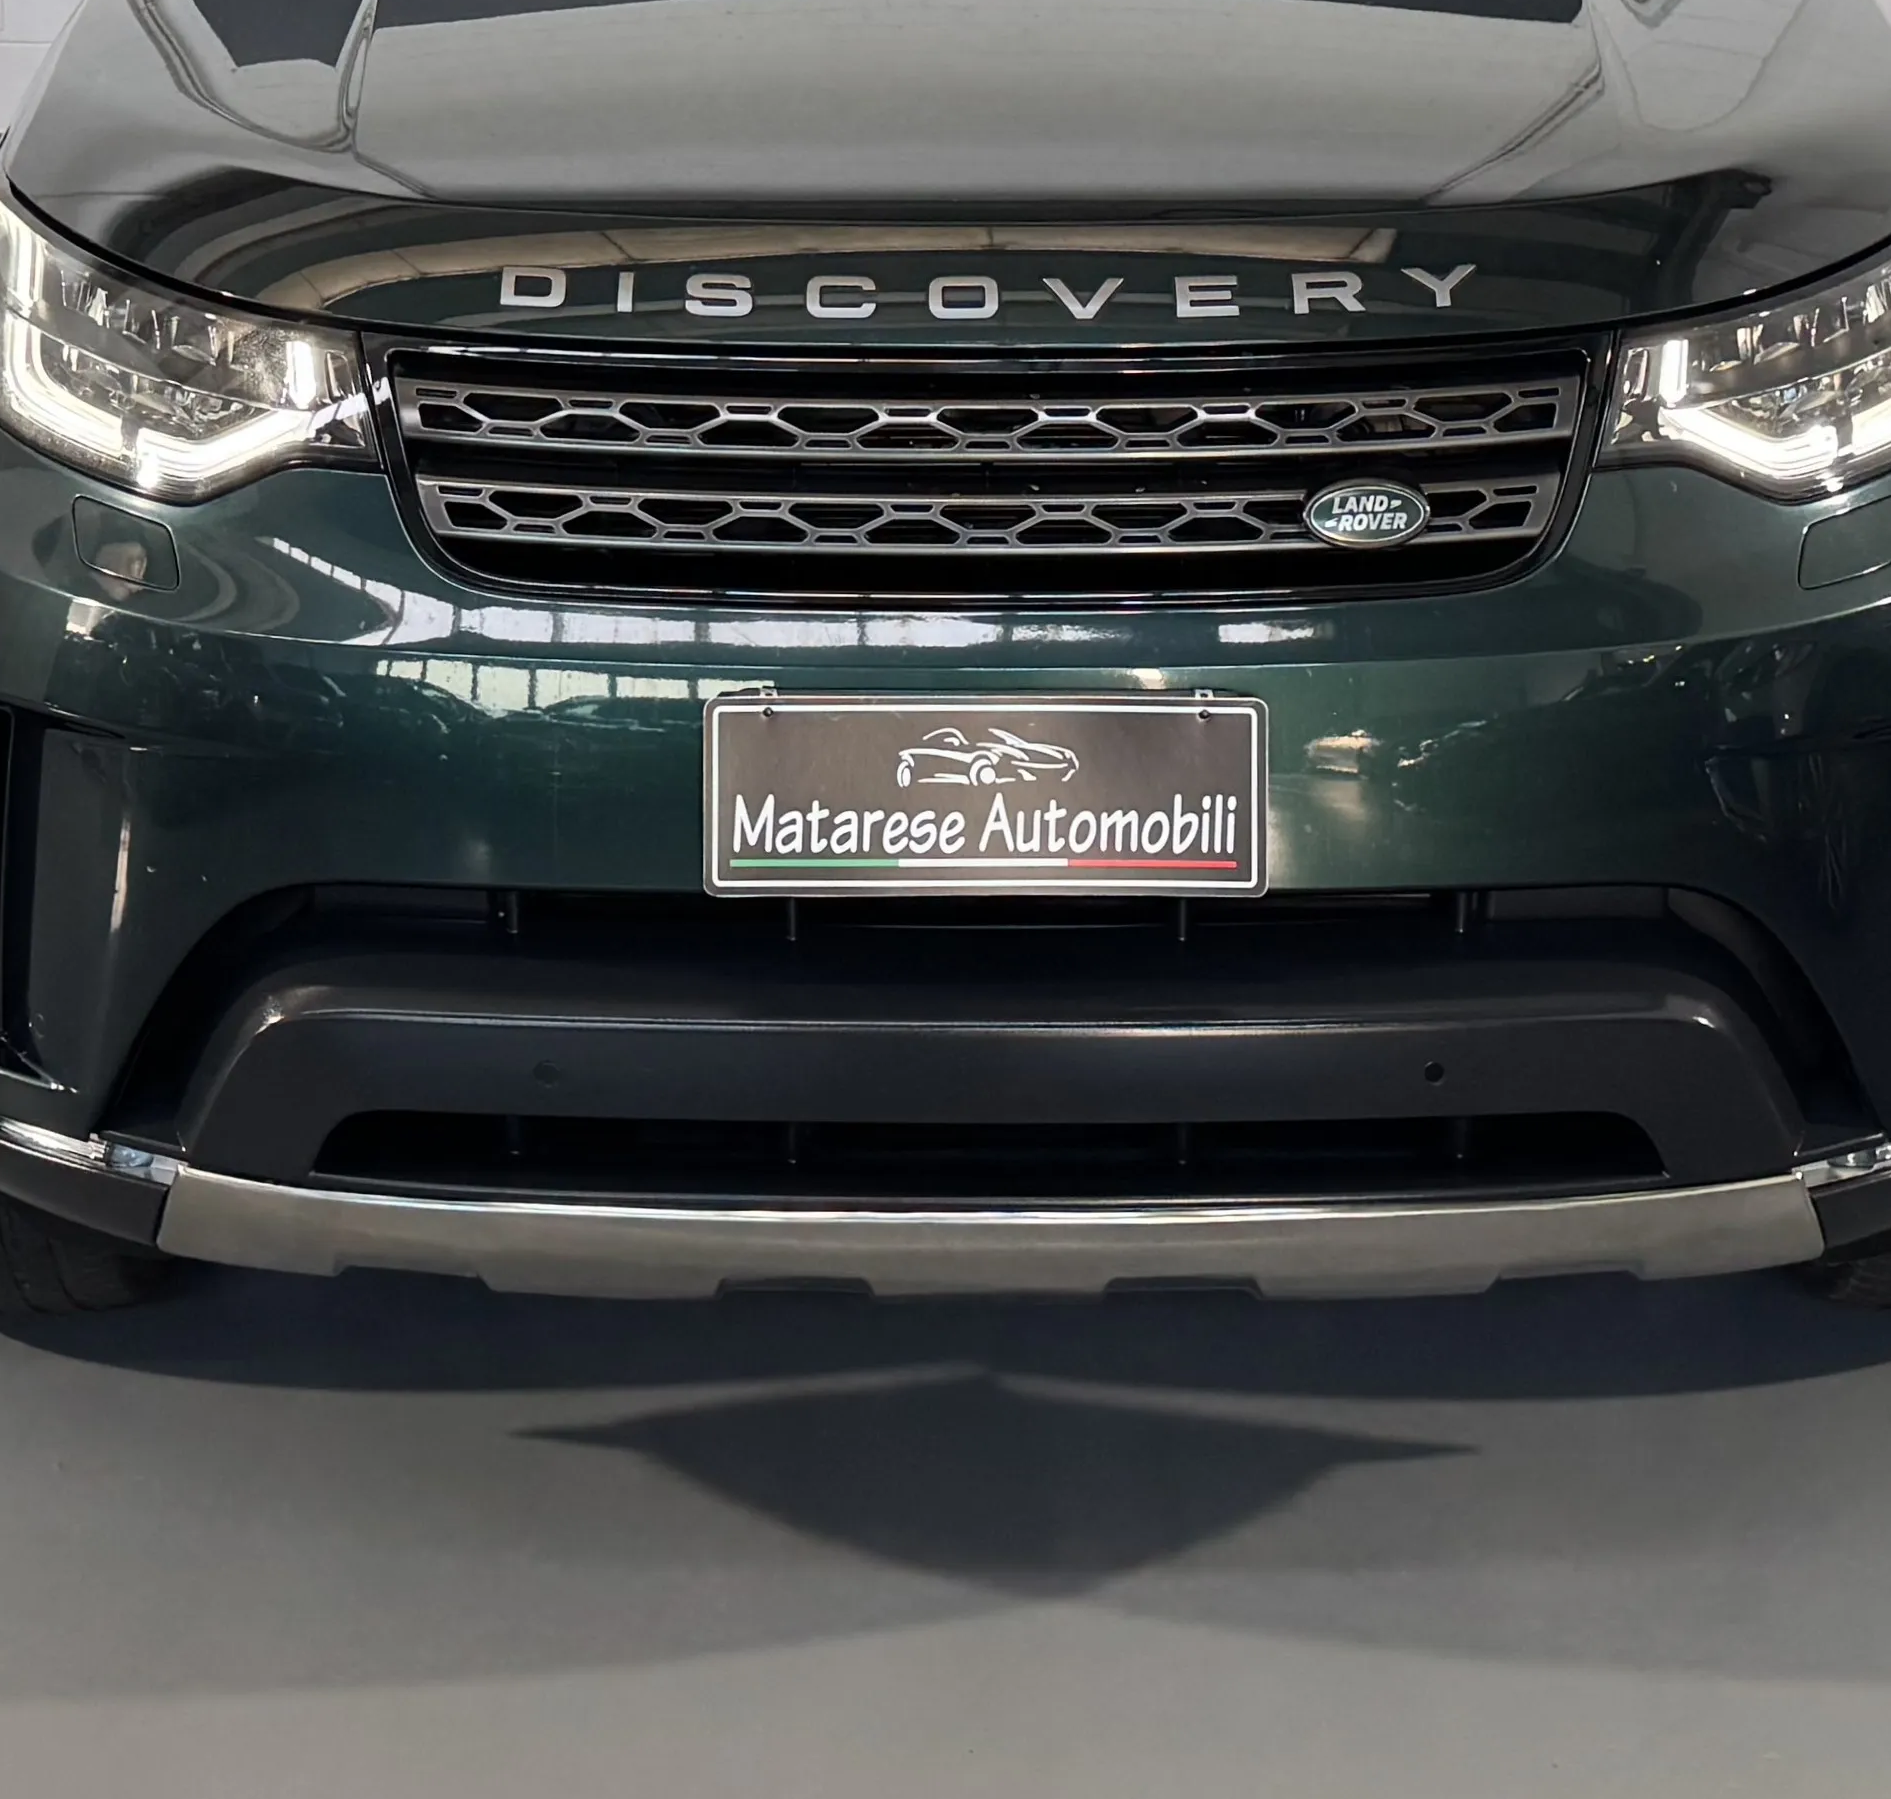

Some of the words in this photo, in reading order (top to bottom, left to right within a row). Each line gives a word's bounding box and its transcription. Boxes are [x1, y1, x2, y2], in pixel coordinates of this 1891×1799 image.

[499, 264, 1477, 320] DISCOVERY
[1332, 495, 1389, 514] LAND
[1338, 512, 1408, 532] ROVER
[732, 793, 966, 855] Matarese
[978, 792, 1238, 855] Automobili
